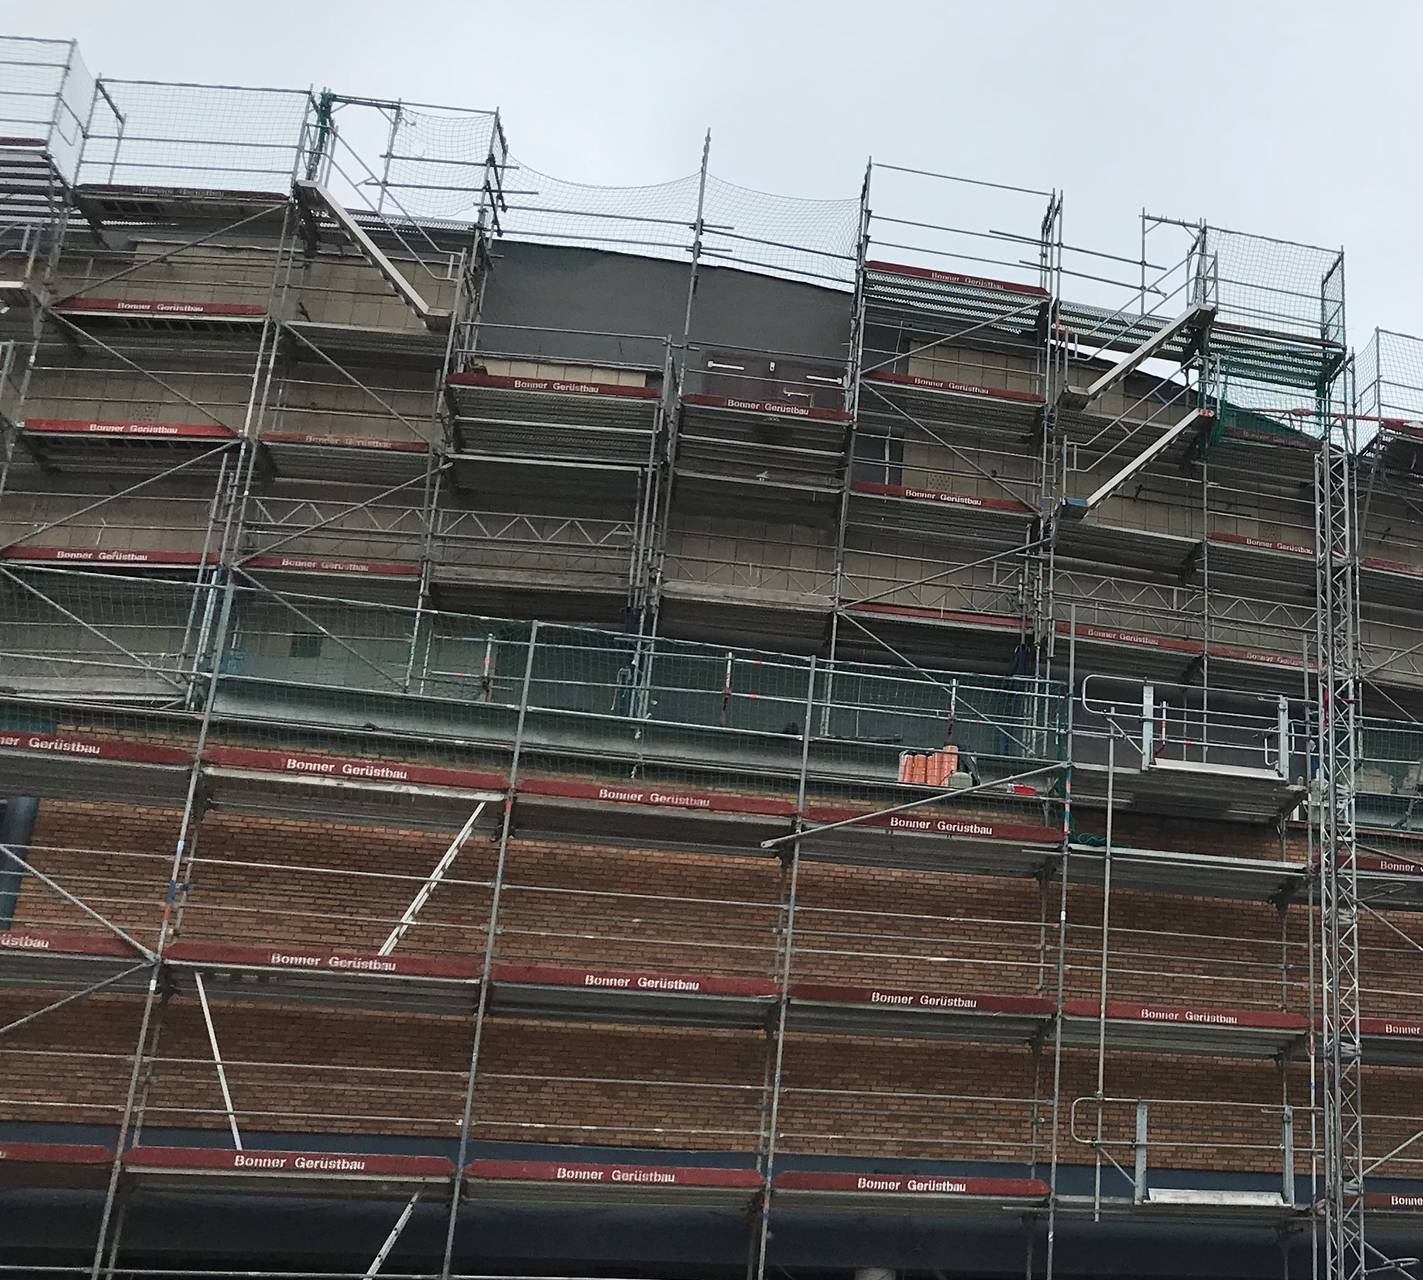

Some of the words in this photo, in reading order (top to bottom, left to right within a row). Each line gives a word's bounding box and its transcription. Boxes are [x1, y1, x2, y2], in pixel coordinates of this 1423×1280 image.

[931, 272, 961, 282] Bonner
[117, 301, 151, 311] Bonner
[514, 380, 548, 390] Bonner
[552, 382, 599, 393] Gerüstbau
[914, 378, 945, 388] Bonner
[727, 400, 760, 410] Bonner
[89, 423, 125, 433] Bonner
[129, 425, 178, 434] Gerüstbau
[906, 489, 936, 499] Bonner
[940, 493, 982, 505] Gerüstbau
[57, 551, 93, 561] Bonner
[98, 551, 148, 563] Gerüstbau
[29, 737, 100, 754] Gerüstbau
[286, 759, 335, 773] Bonner
[342, 762, 408, 780] Gerüstbau
[599, 789, 644, 801] Bonner
[649, 793, 709, 808] Gerüstbau
[890, 817, 931, 829] Bonner
[936, 820, 993, 835] Gerüstbau
[1380, 861, 1415, 872] Bonner
[271, 953, 321, 965] Bonner
[328, 955, 396, 971] Gerüstbau
[585, 975, 631, 988] Bonner
[637, 976, 700, 991] Gerüstbau
[871, 992, 913, 1004] Bonner
[919, 995, 977, 1008] Gerüstbau
[1141, 1008, 1178, 1019] Bonner
[1185, 1011, 1238, 1023] Gerüstbau
[1385, 1024, 1420, 1035] Bonner
[234, 1155, 287, 1169] Bonner
[294, 1157, 365, 1172] Gerüstbau
[557, 1168, 604, 1180] Bonner
[611, 1169, 676, 1183] Gerüstbau
[857, 1178, 900, 1191] Bonner
[907, 1179, 966, 1193] Gerüstbau
